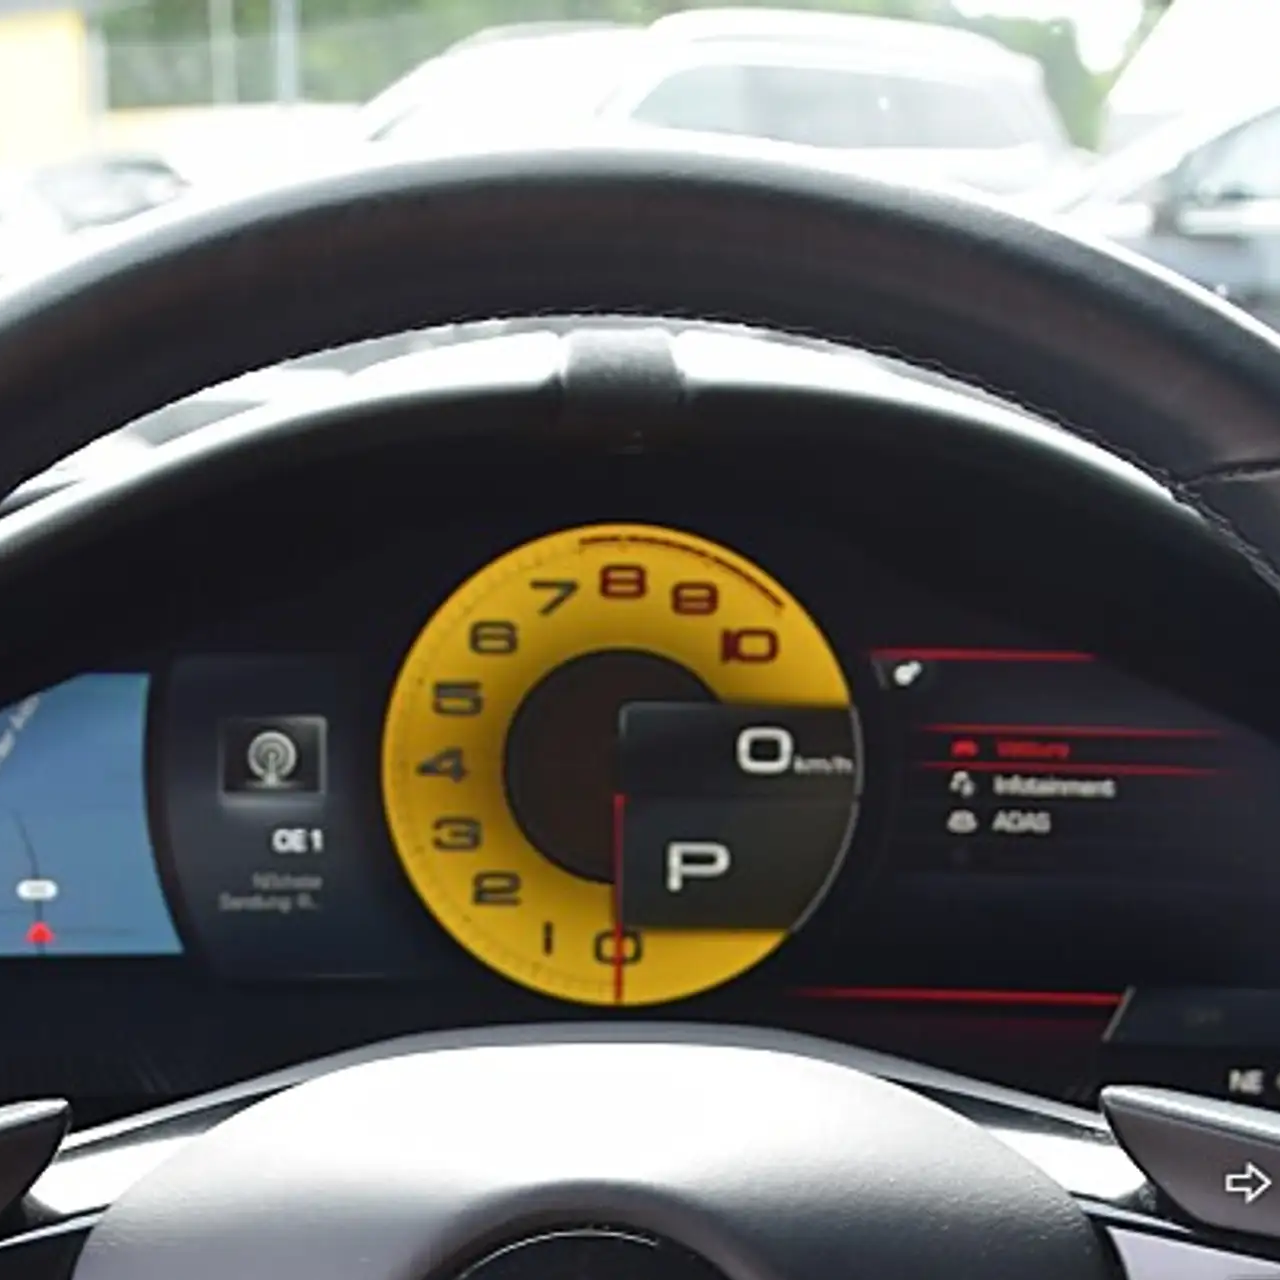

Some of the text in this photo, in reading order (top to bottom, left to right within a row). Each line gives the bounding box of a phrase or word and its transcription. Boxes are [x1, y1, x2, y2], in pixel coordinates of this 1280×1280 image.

[530, 580, 579, 616] 7
[600, 564, 647, 599] 8
[469, 621, 518, 655] 6
[722, 629, 779, 664] 10
[433, 682, 482, 717] 5
[417, 748, 467, 783] 4
[737, 727, 793, 774] 0
[432, 818, 482, 852] 3
[992, 810, 1052, 833] ADAS
[666, 842, 731, 892] P
[472, 872, 522, 905] 2
[594, 930, 642, 965] 0
